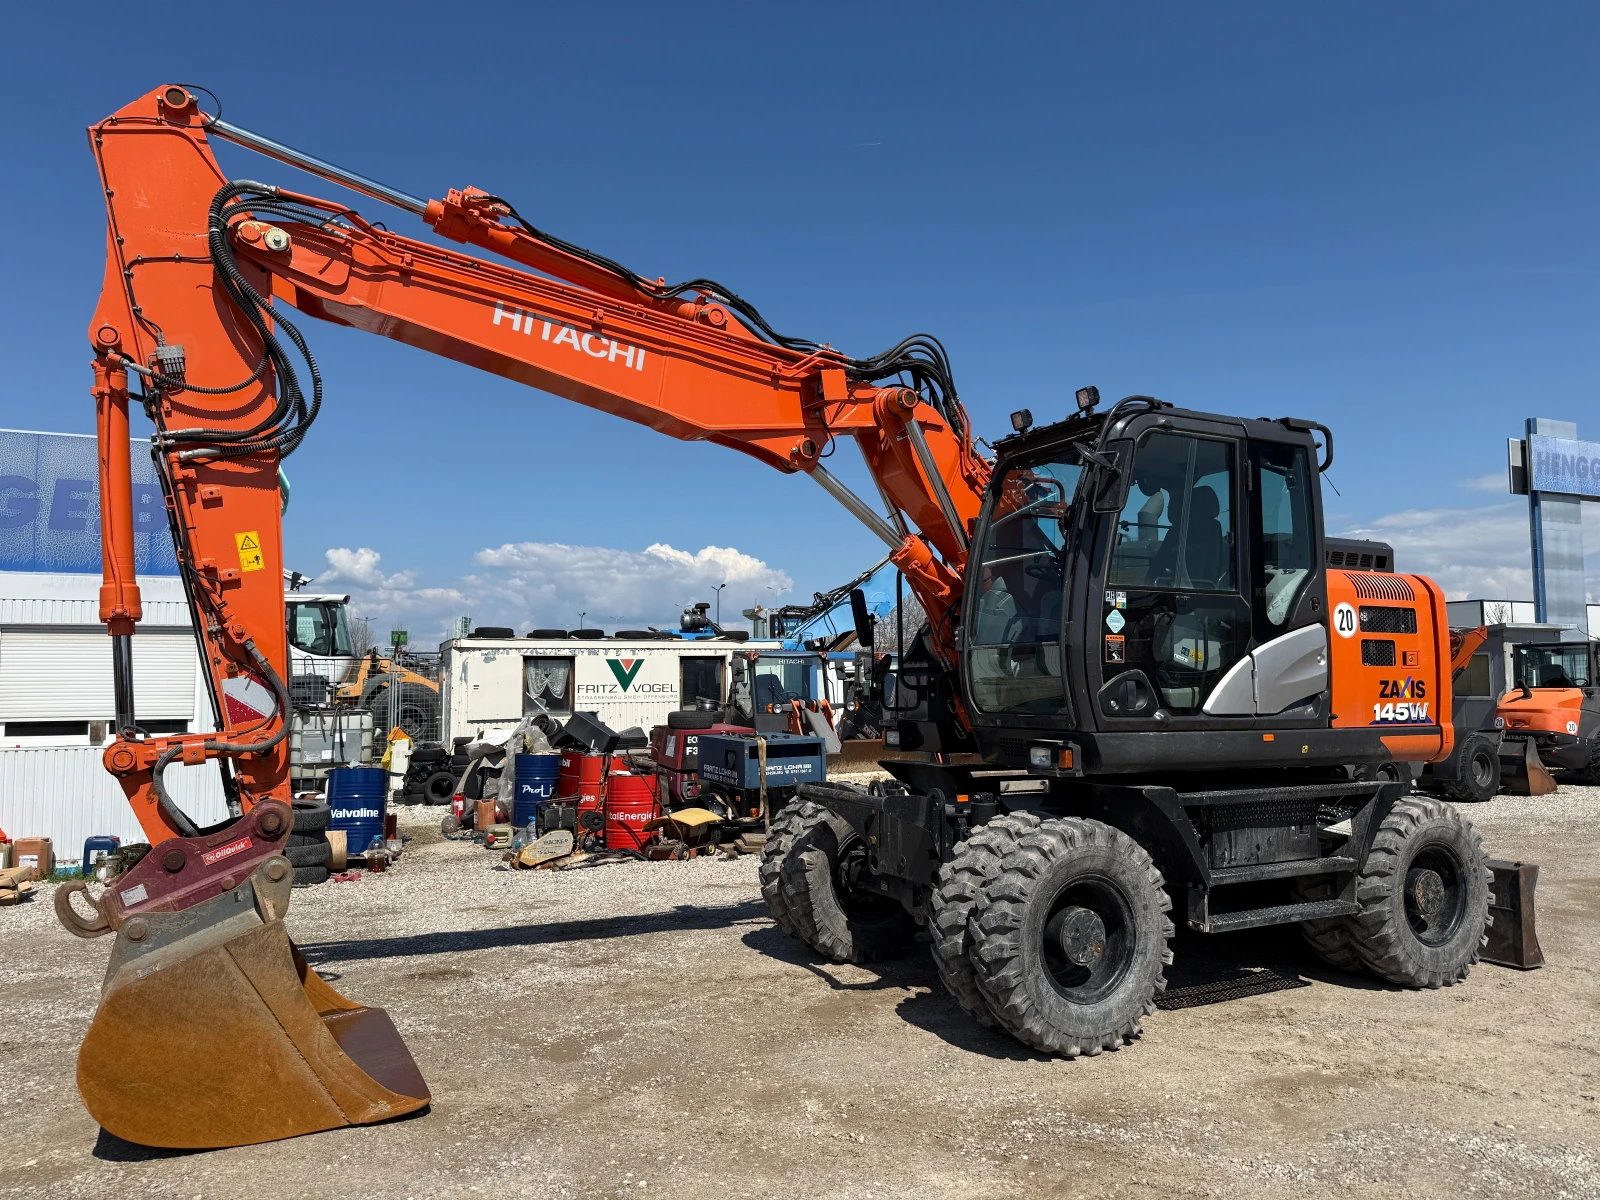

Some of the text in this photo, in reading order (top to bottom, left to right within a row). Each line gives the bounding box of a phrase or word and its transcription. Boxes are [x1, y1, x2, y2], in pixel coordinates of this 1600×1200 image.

[493, 301, 646, 371] HITACHI
[1537, 452, 1600, 480] HENGG
[1338, 608, 1354, 632] 20
[577, 683, 678, 694] FRITZ VOGEL
[1379, 676, 1426, 698] ZAXIS
[1373, 702, 1430, 721] 145W
[1495, 718, 1503, 727] 20
[1568, 723, 1576, 732] 20
[330, 807, 380, 819] Valvoline
[215, 842, 246, 859] OilQuick
